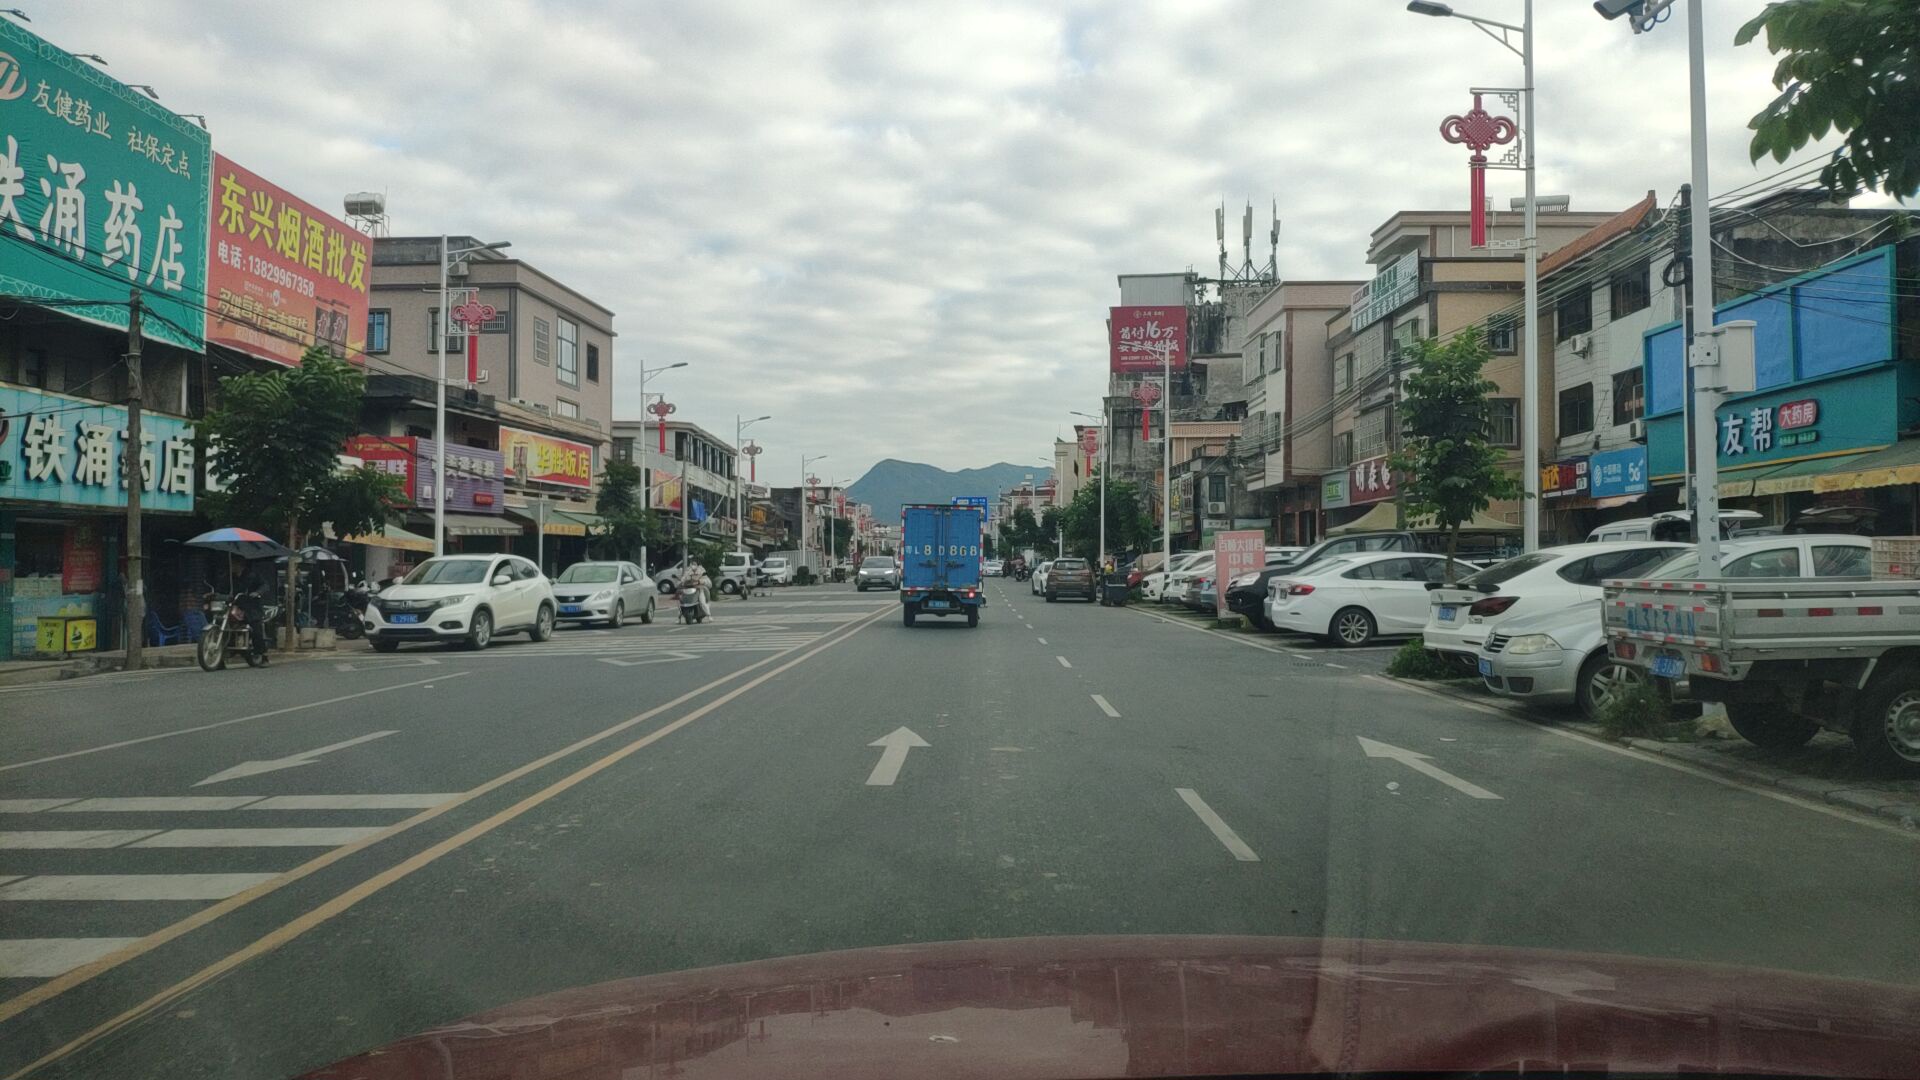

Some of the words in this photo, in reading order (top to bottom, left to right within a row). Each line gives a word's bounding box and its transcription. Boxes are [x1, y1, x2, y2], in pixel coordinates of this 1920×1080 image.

[32, 80, 112, 140] 友健药业
[127, 126, 191, 180] 社保定点
[219, 173, 367, 293] 东兴烟酒批发
[1781, 402, 1815, 427] 大药房
[25, 415, 195, 494] 铁涌药店
[537, 446, 589, 480] 华胜饭店
[1628, 462, 1641, 482] 5G
